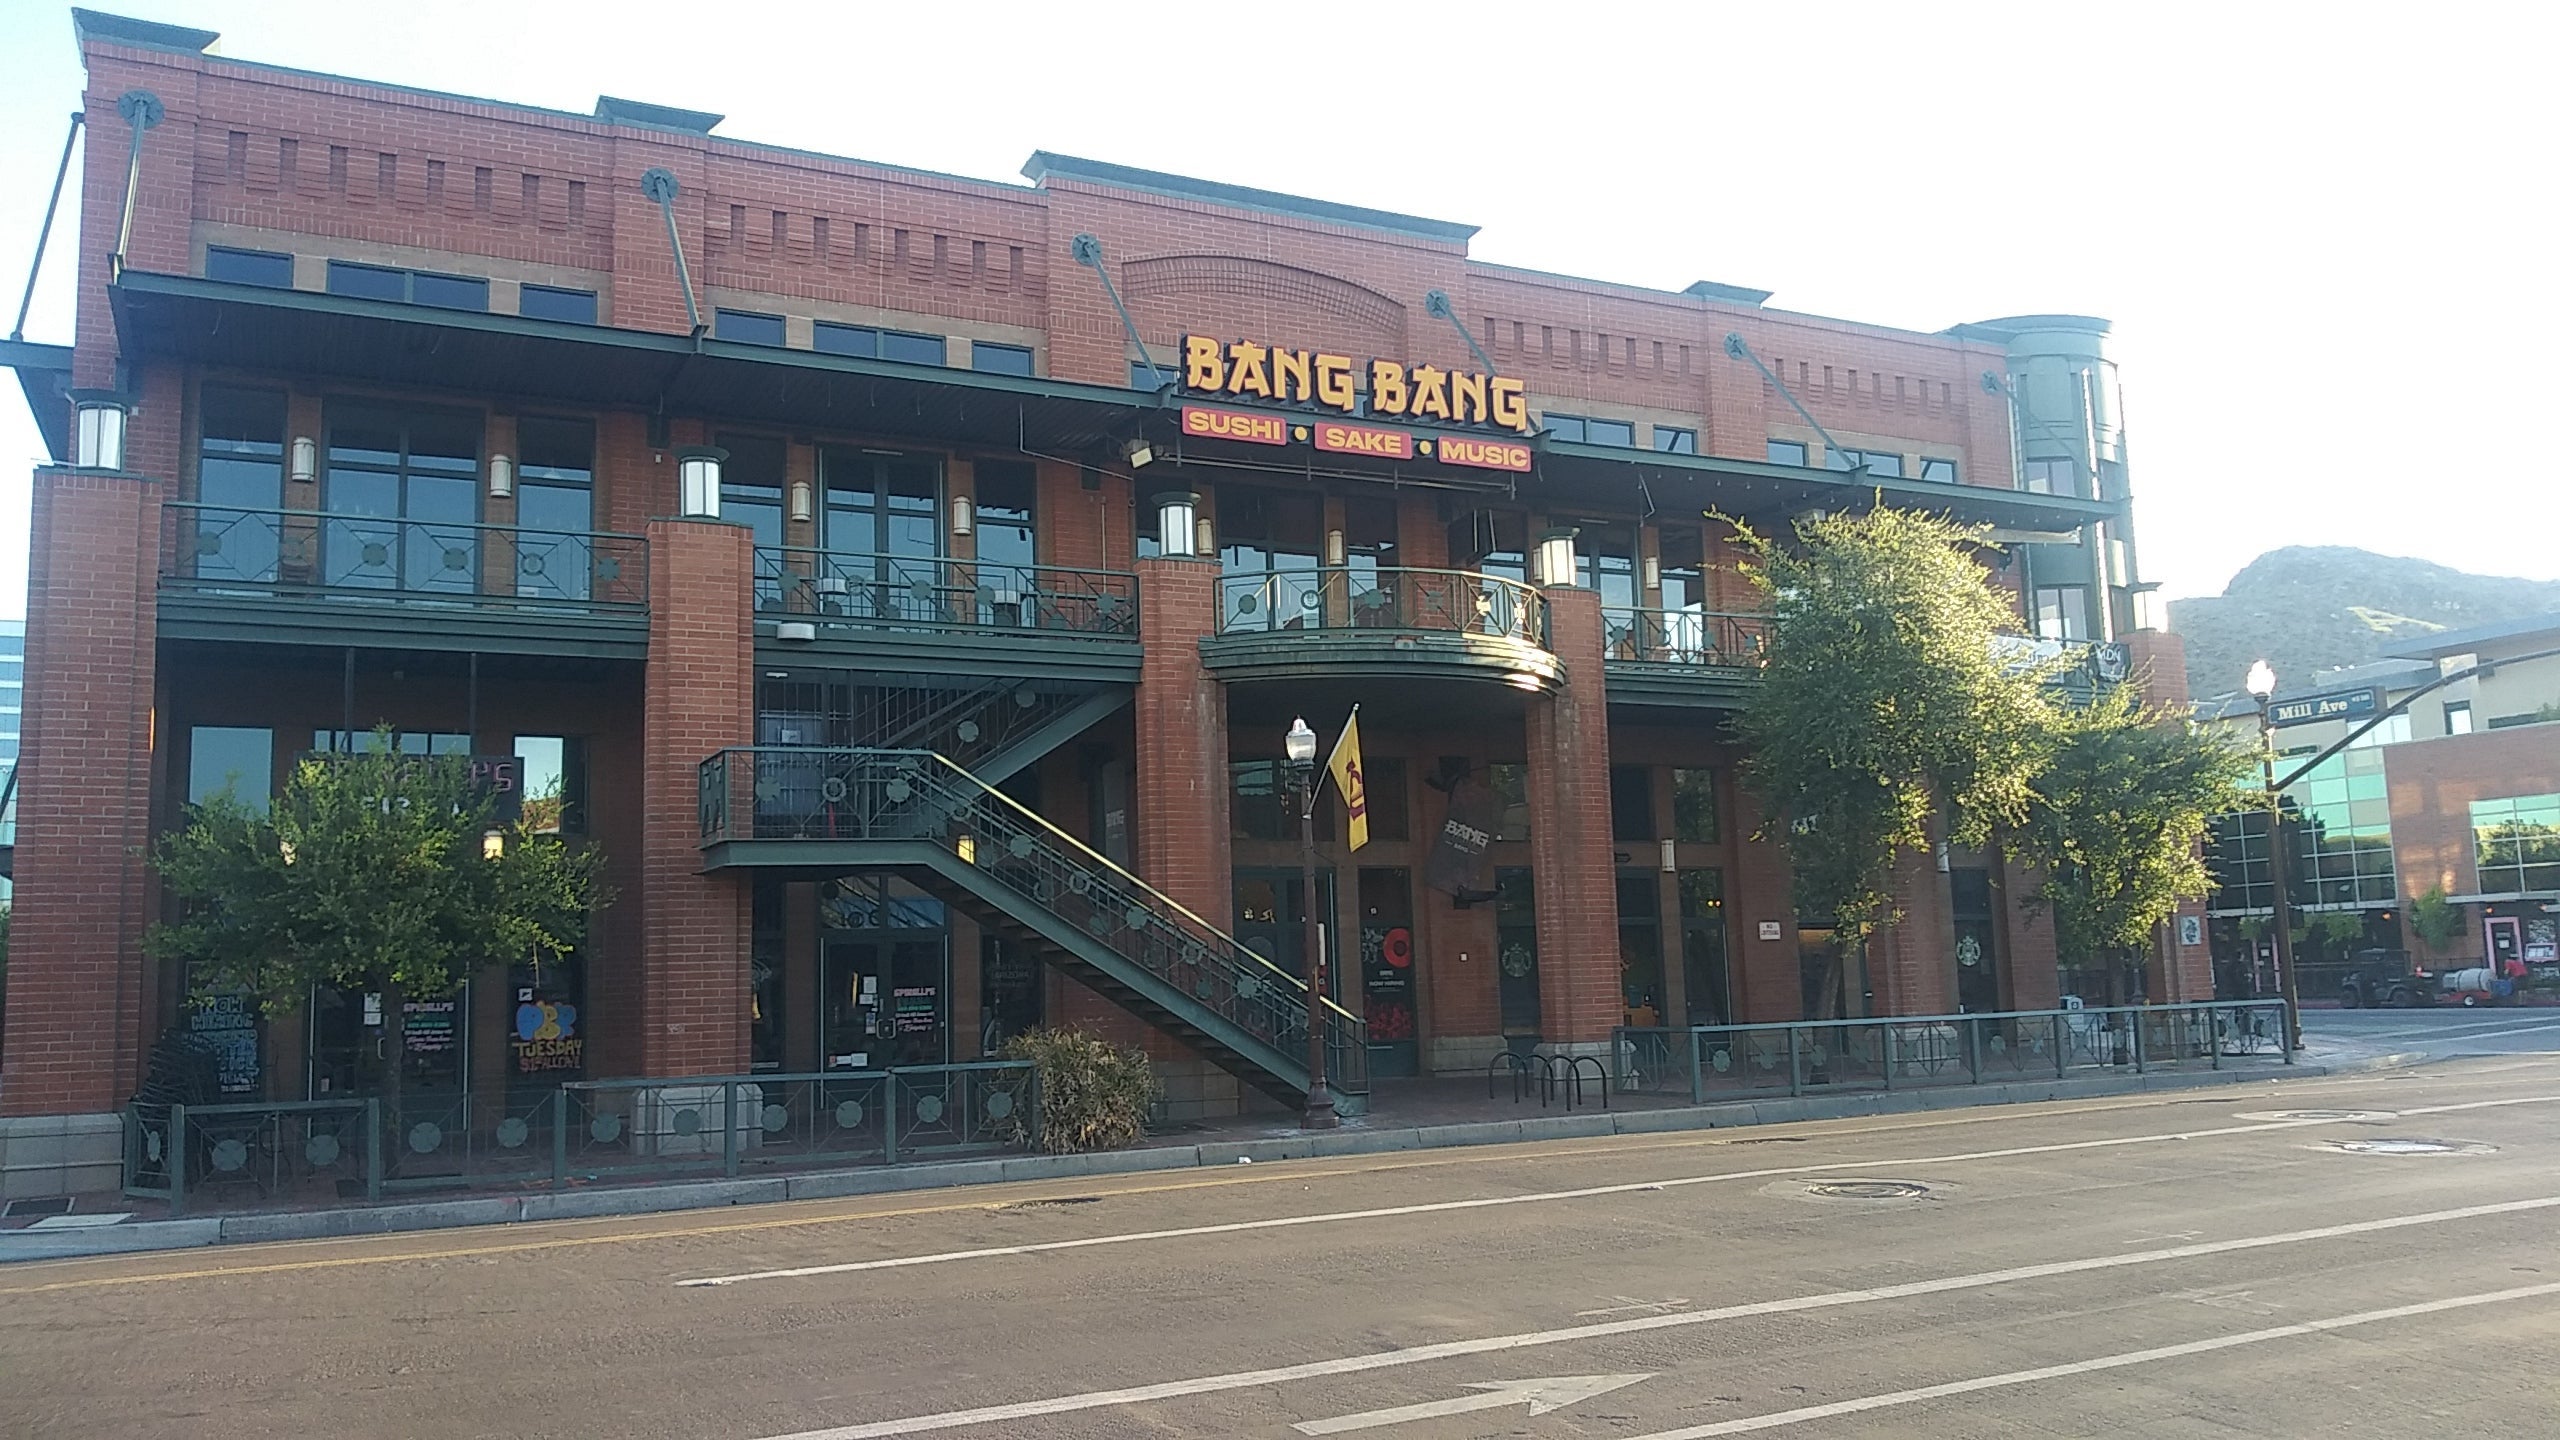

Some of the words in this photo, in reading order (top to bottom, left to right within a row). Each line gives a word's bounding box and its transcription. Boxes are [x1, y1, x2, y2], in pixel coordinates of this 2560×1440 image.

[1186, 334, 1355, 412] BANG
[1372, 358, 1527, 432] BANG
[1188, 411, 1281, 440] SUSHI
[1325, 428, 1402, 454] SAKE
[1441, 440, 1528, 468] MUSIC
[2278, 703, 2312, 720] Mill
[2318, 700, 2348, 714] Ave
[511, 1039, 582, 1057] TUESDAY
